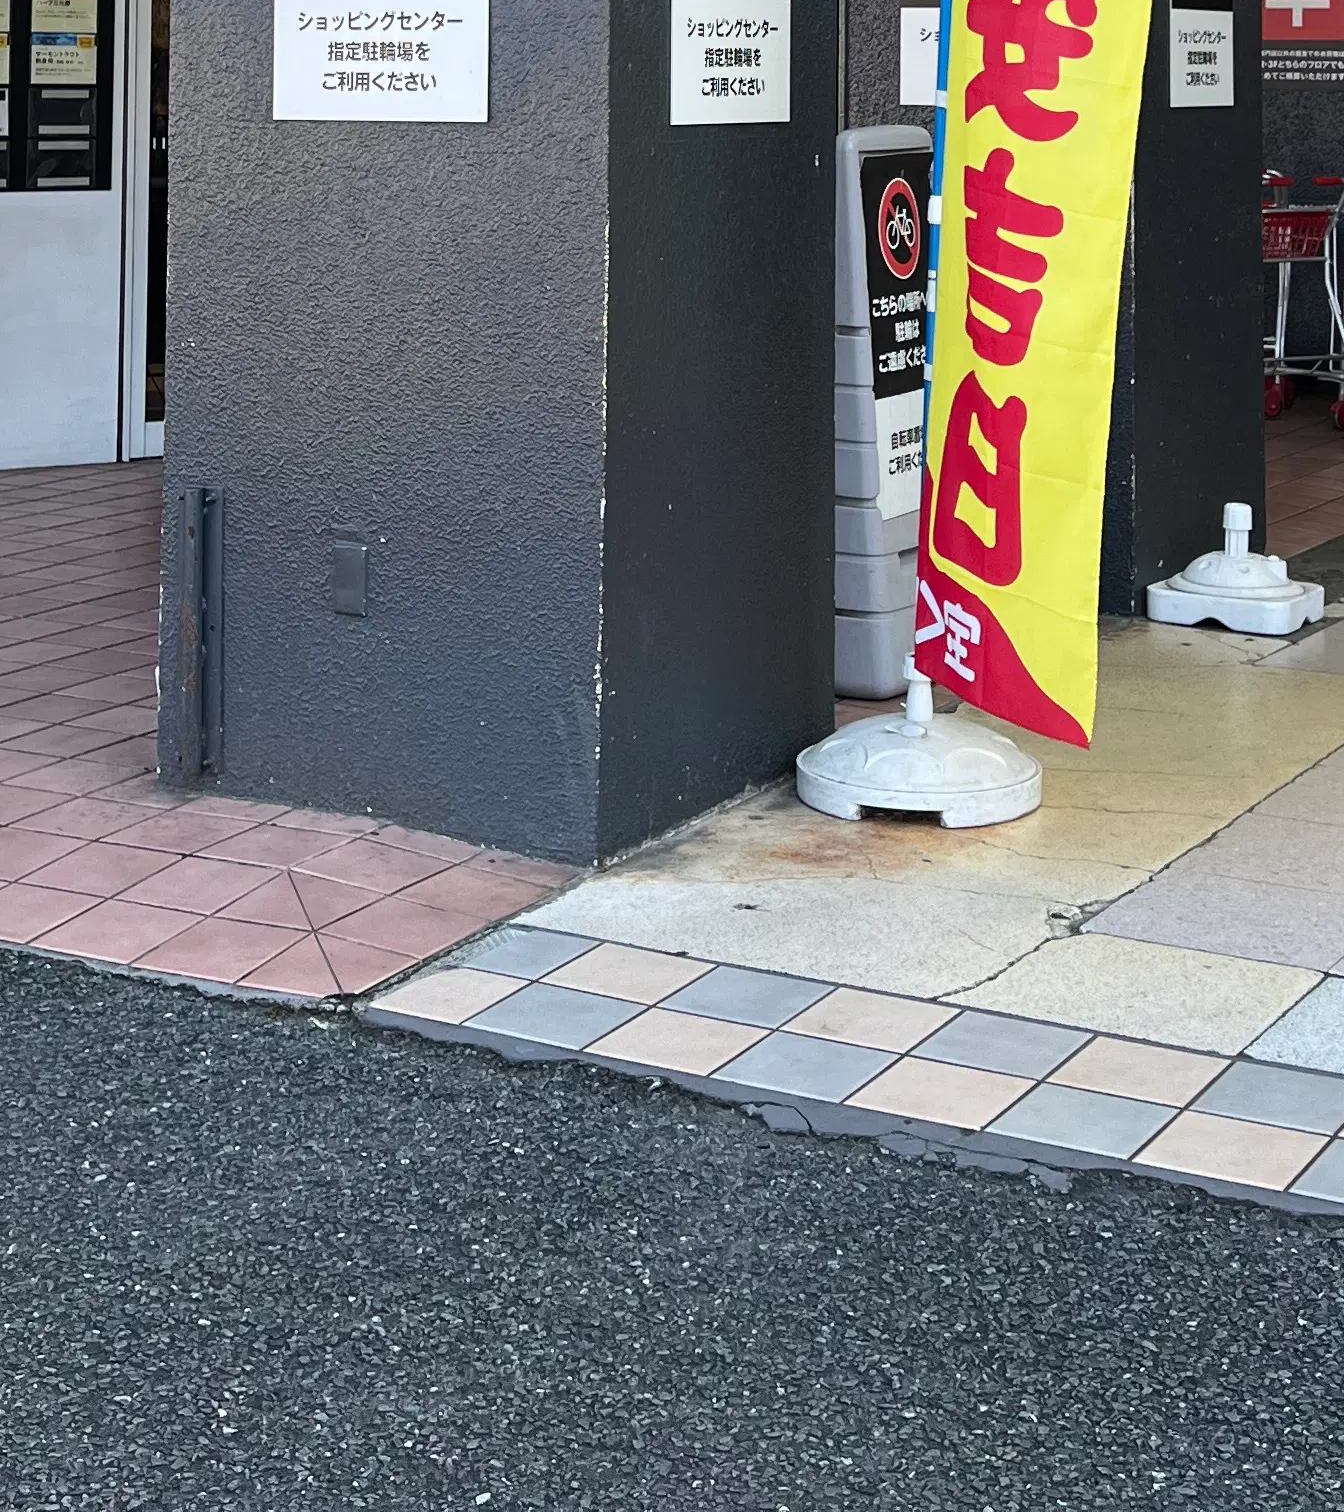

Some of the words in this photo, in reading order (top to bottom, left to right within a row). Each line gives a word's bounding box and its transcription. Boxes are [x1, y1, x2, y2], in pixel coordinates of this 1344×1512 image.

[297, 10, 464, 32] ショッピングセンター
[686, 17, 778, 39] ショッピングセンター
[327, 41, 431, 62] 指定駐輪場を
[704, 47, 762, 68] 指定駐輪場を
[322, 71, 437, 92] ご利用ください
[701, 76, 766, 97] ご利用ください
[872, 291, 927, 317] こちらの場所へ
[878, 344, 926, 373] ご遠慮くださ
